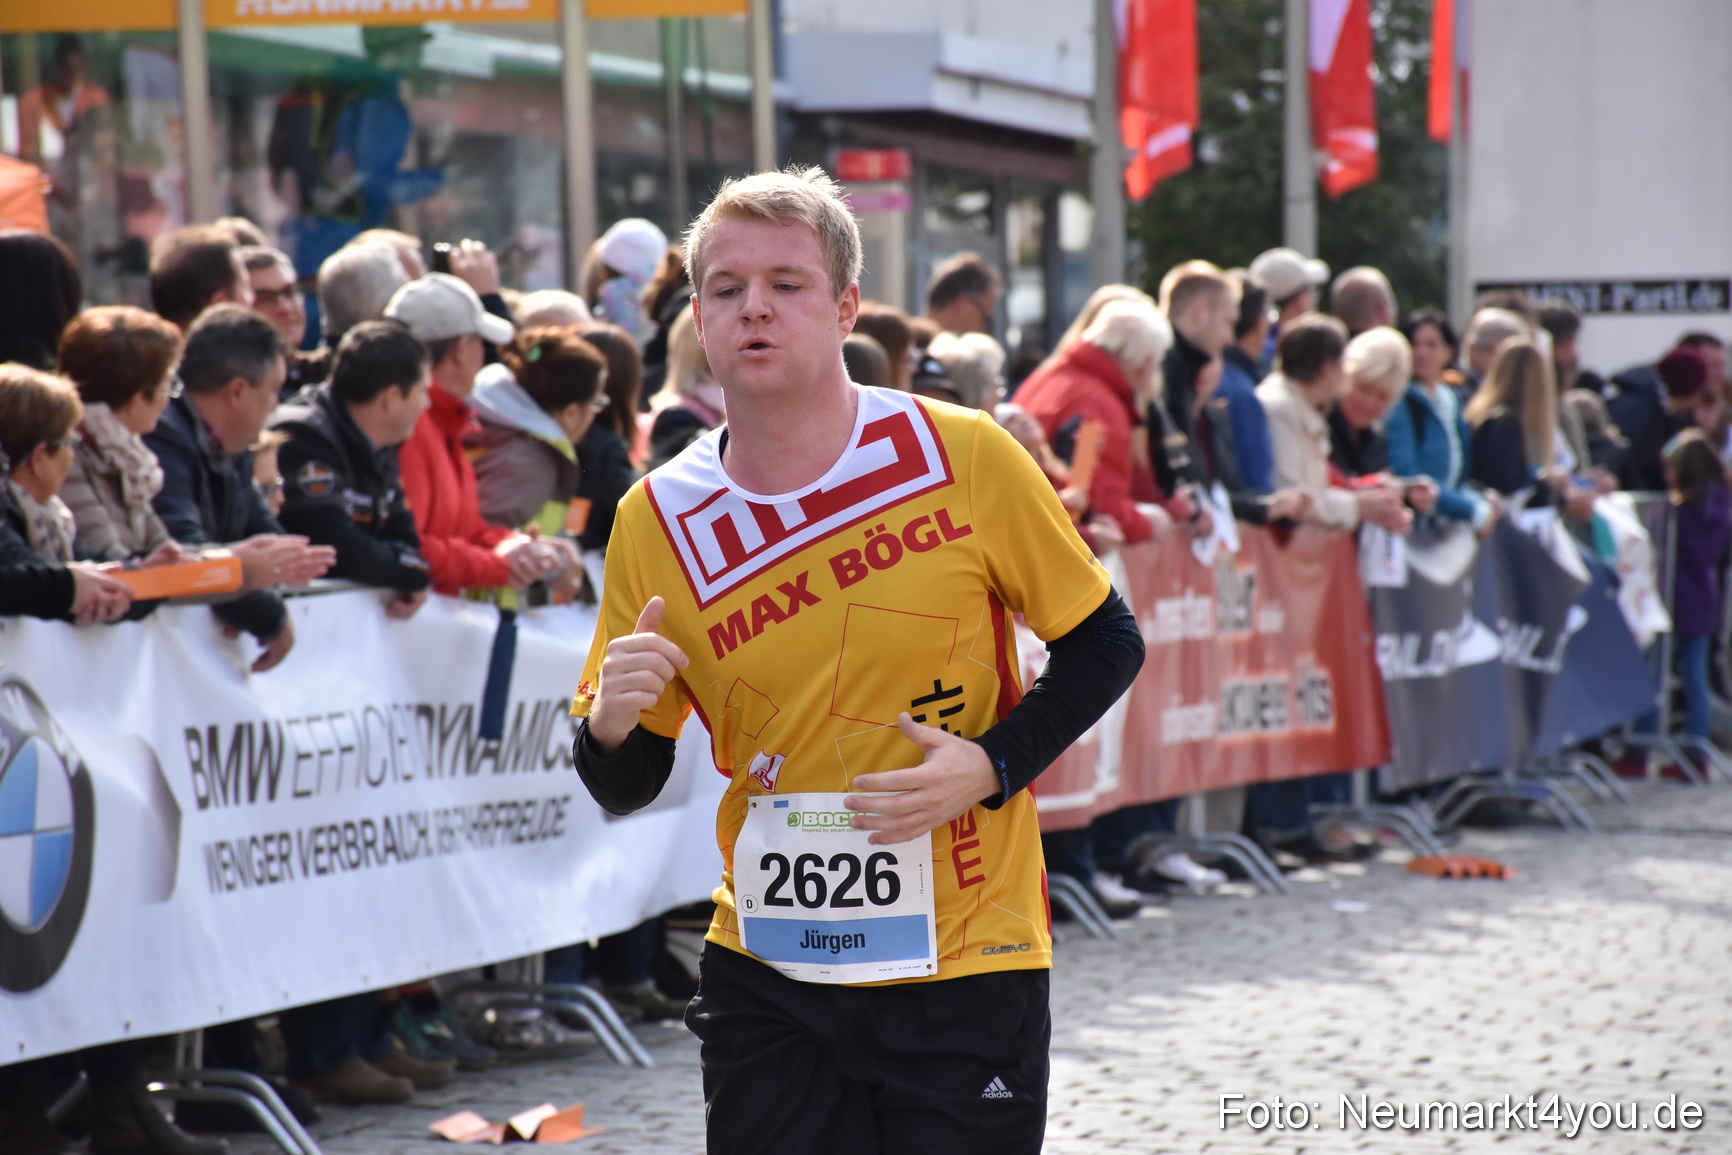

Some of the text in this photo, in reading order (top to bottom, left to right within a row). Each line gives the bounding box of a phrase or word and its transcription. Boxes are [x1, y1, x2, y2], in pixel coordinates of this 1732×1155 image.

[707, 508, 973, 661] MAX BÖGL
[184, 720, 285, 811] BMW
[203, 831, 294, 894] WENIGER
[760, 851, 900, 909] 2626
[746, 899, 753, 909] D
[800, 929, 866, 955] Jürgen
[981, 1090, 1013, 1099] adidas
